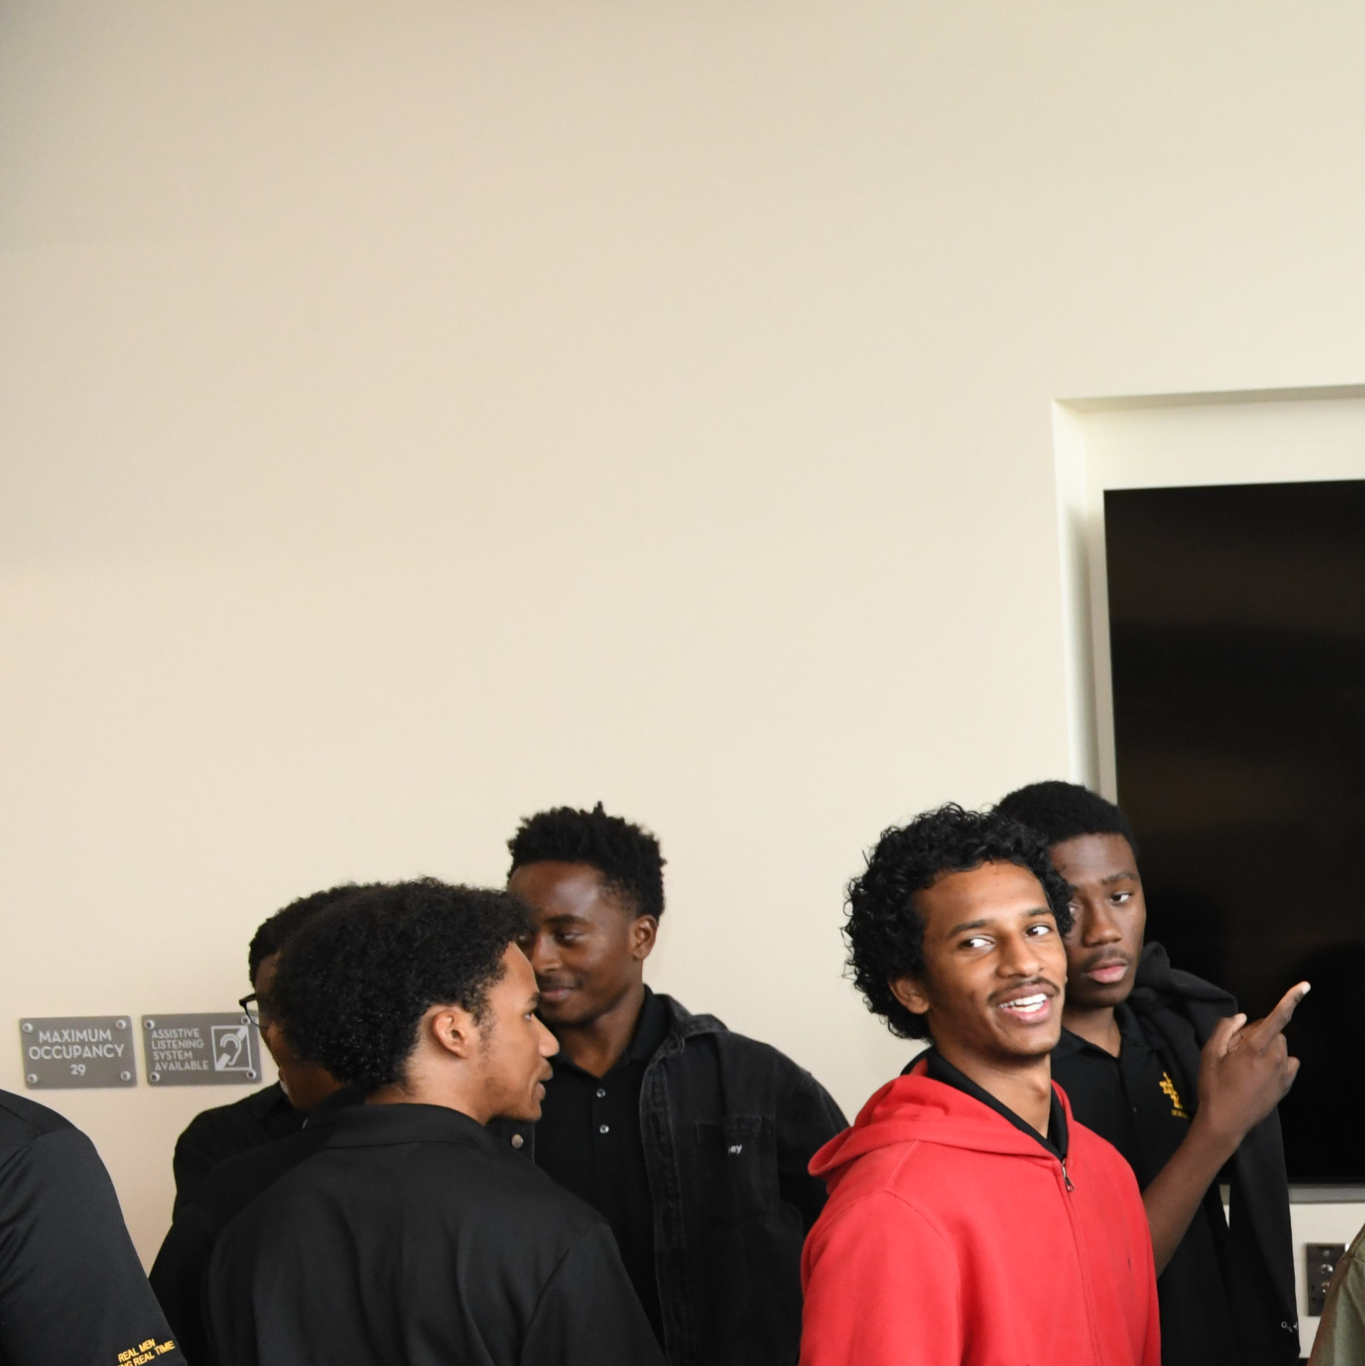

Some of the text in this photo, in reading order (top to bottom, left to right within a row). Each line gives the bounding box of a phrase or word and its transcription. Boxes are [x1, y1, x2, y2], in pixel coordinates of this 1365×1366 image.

[38, 1029, 112, 1043] MAXIMUM
[151, 1028, 200, 1039] ASSISTIVE
[151, 1039, 204, 1050] LISTENING
[28, 1044, 124, 1060] OCCUPANCY
[153, 1050, 193, 1061] SYSTEM
[70, 1064, 86, 1076] 29
[154, 1060, 209, 1071] AVAILABLE
[117, 1338, 156, 1363] REAL MEN
[133, 1351, 155, 1366] REAL
[153, 1340, 176, 1355] TIME
